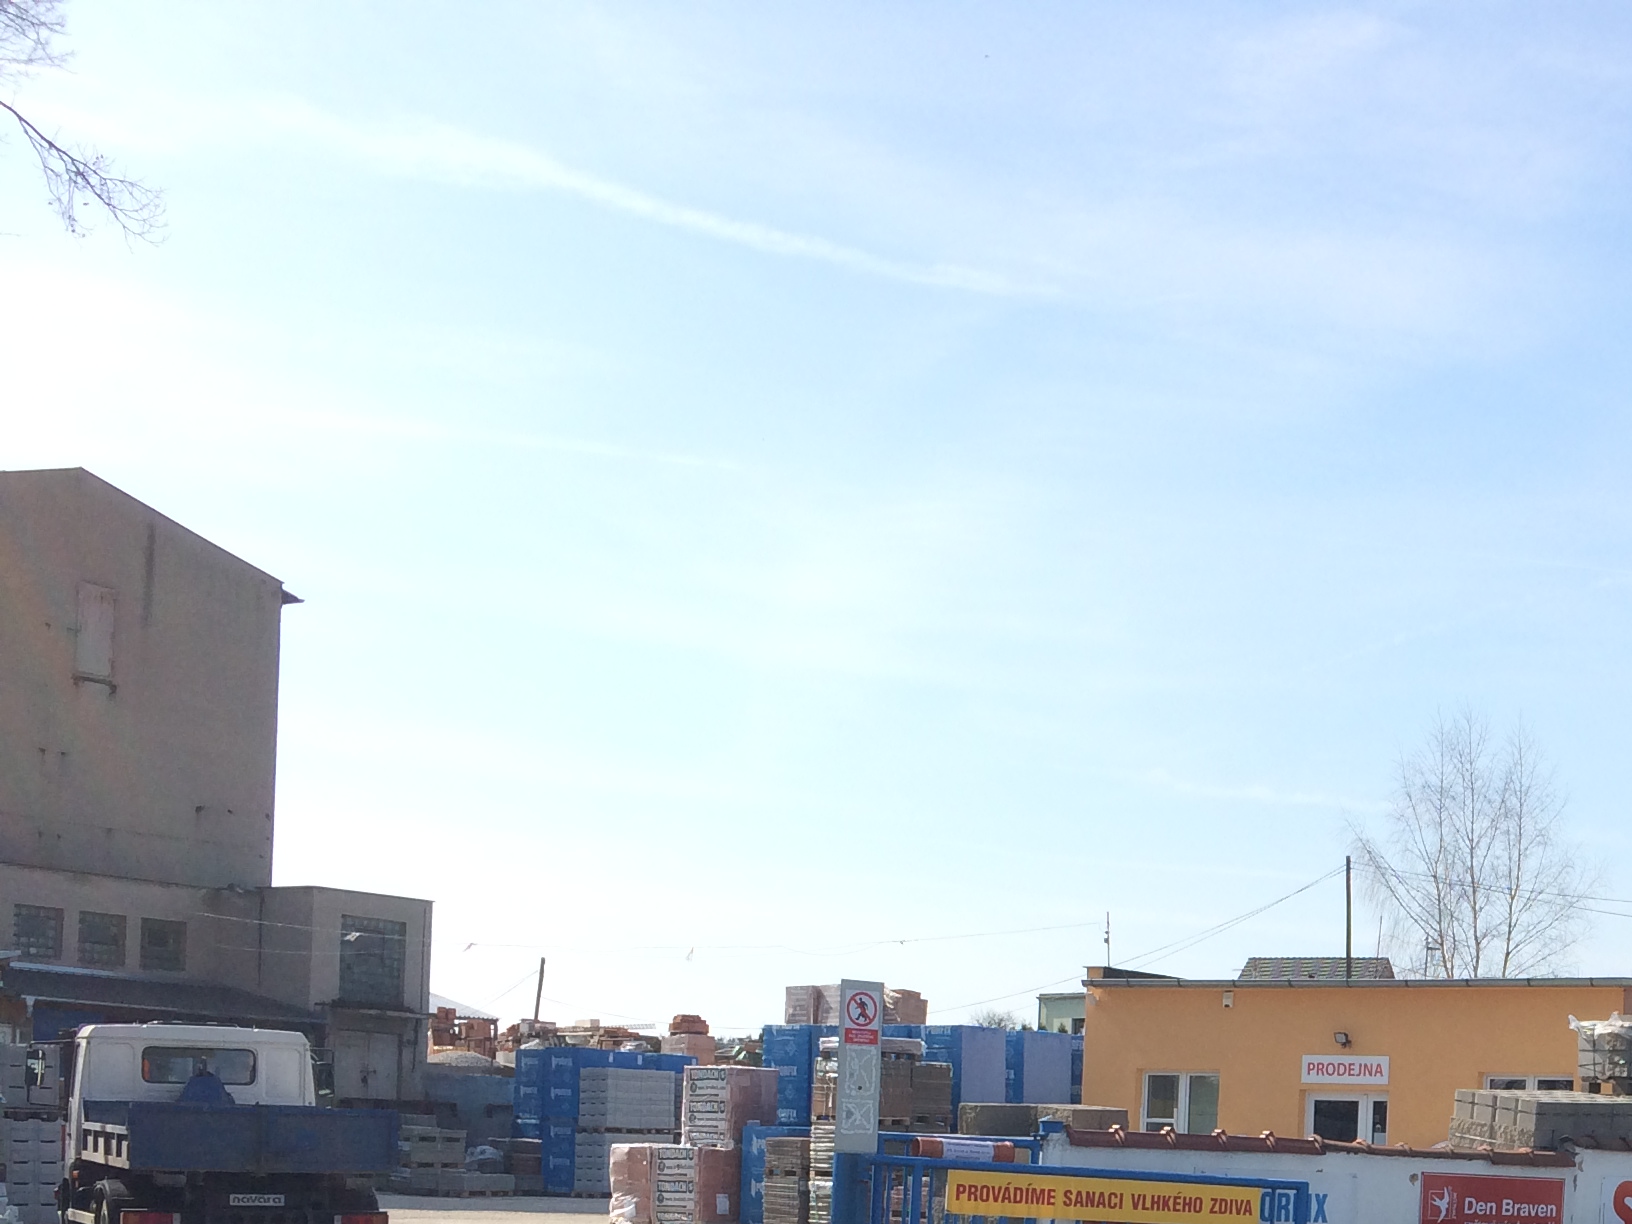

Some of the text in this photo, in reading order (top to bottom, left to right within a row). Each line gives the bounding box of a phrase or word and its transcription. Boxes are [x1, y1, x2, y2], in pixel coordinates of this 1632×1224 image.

[1307, 1061, 1384, 1078] PRODEJNA
[955, 1182, 1253, 1217] PROVÁDÍME SANACI VLHKÉHO ZDIVA
[1464, 1197, 1496, 1215] Den
[1502, 1199, 1557, 1217] Braven
